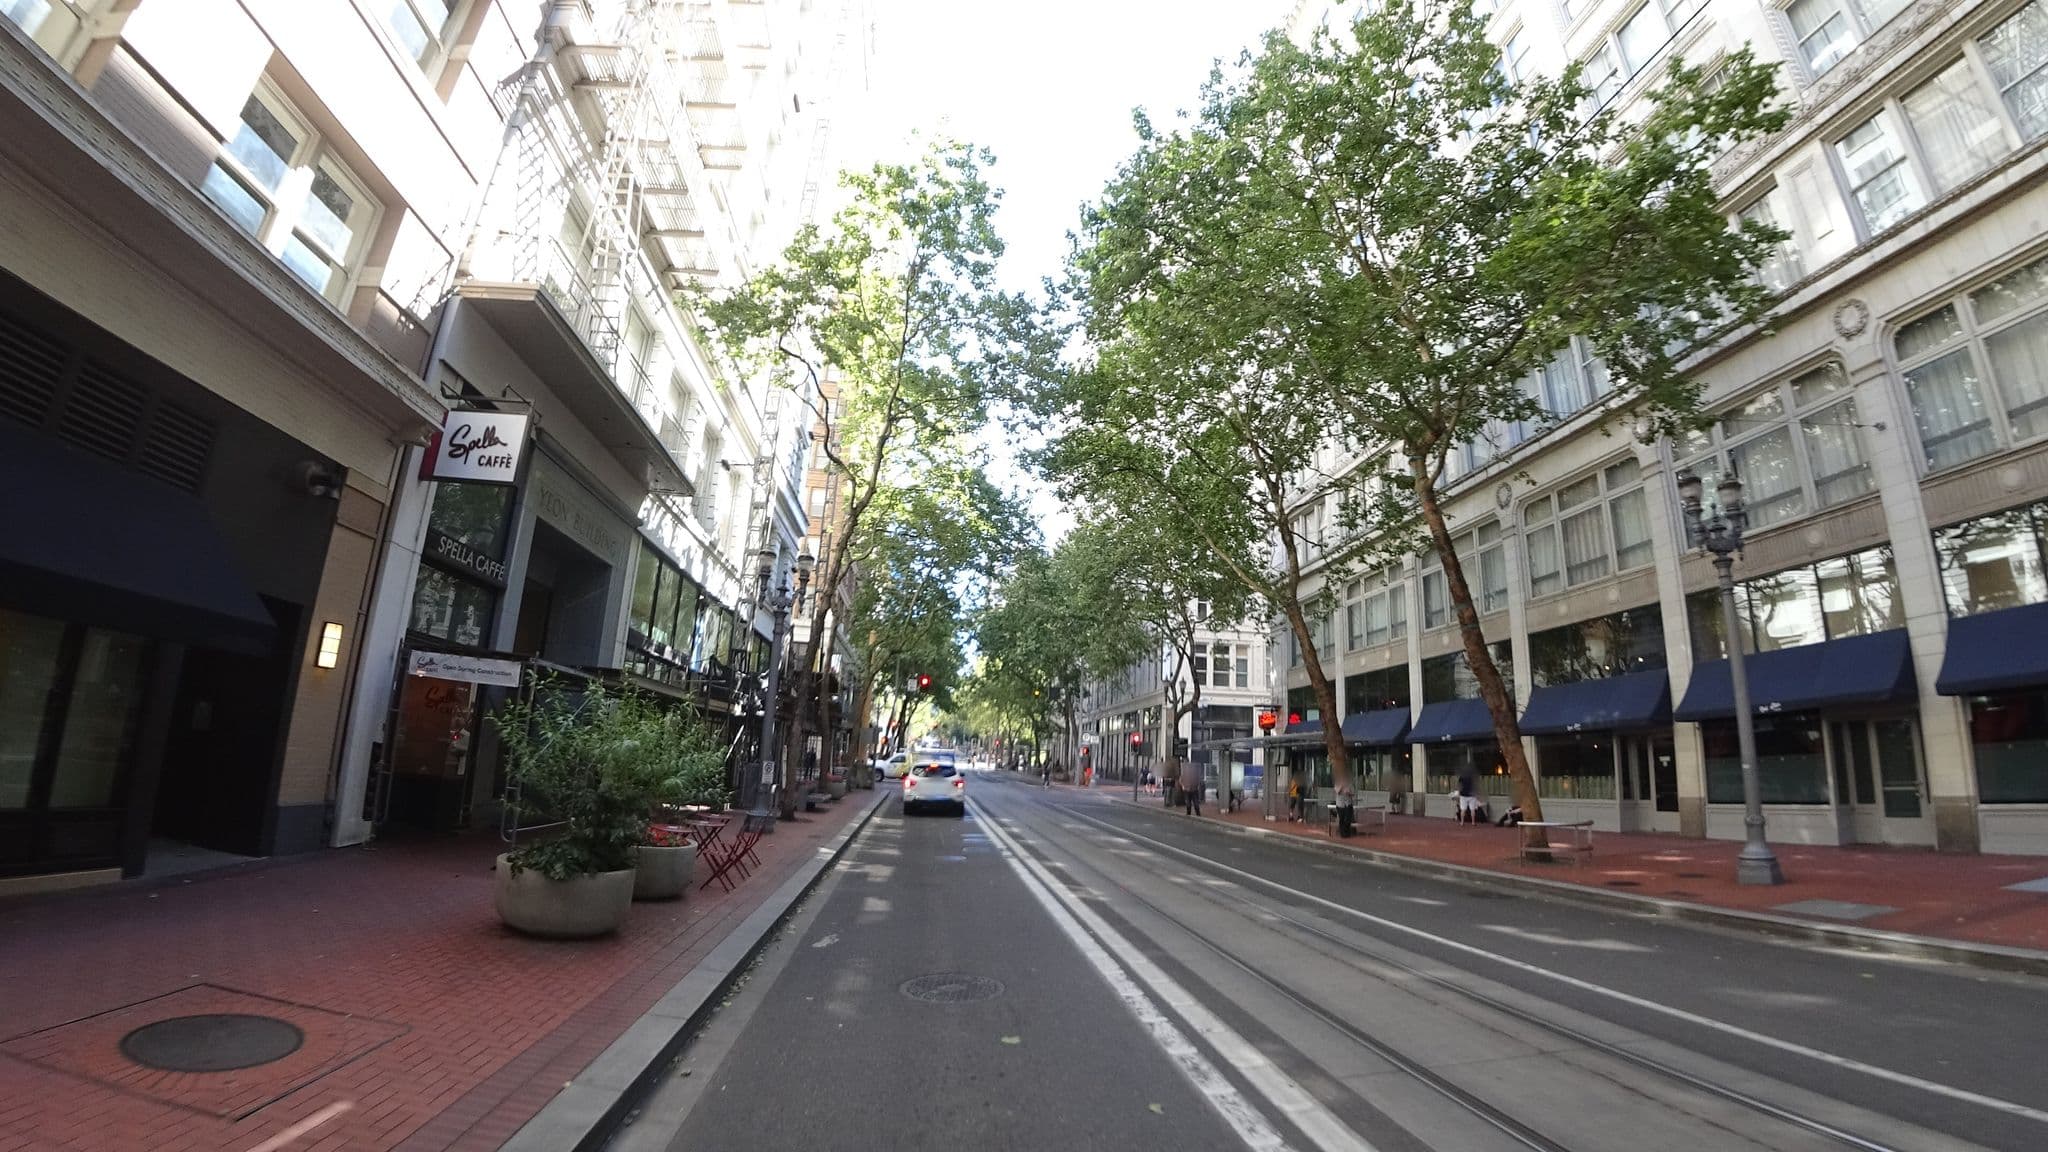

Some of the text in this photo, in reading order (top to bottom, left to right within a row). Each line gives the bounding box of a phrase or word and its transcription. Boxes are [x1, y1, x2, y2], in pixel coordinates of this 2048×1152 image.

[448, 424, 508, 465] Spella
[478, 453, 512, 468] CAFFÈ
[540, 486, 567, 521] YEON
[438, 536, 474, 567] SPELLA
[442, 663, 457, 671] Open
